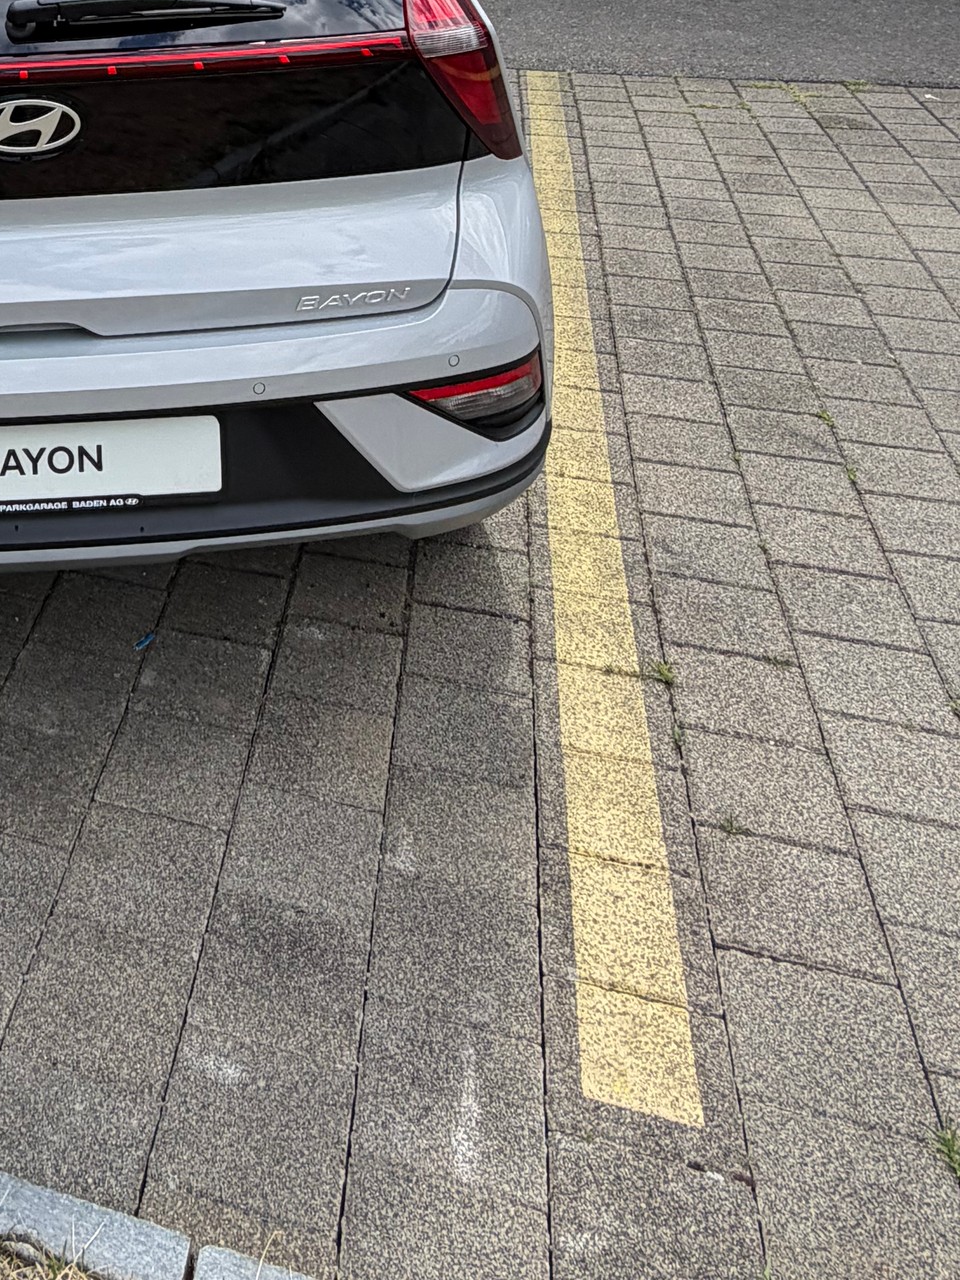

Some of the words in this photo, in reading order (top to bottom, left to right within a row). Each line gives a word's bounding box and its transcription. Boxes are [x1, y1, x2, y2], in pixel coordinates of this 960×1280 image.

[297, 287, 410, 311] BAYON
[0, 502, 68, 513] PARKGARAGE
[72, 500, 107, 509] BADEN
[110, 498, 124, 507] AG
